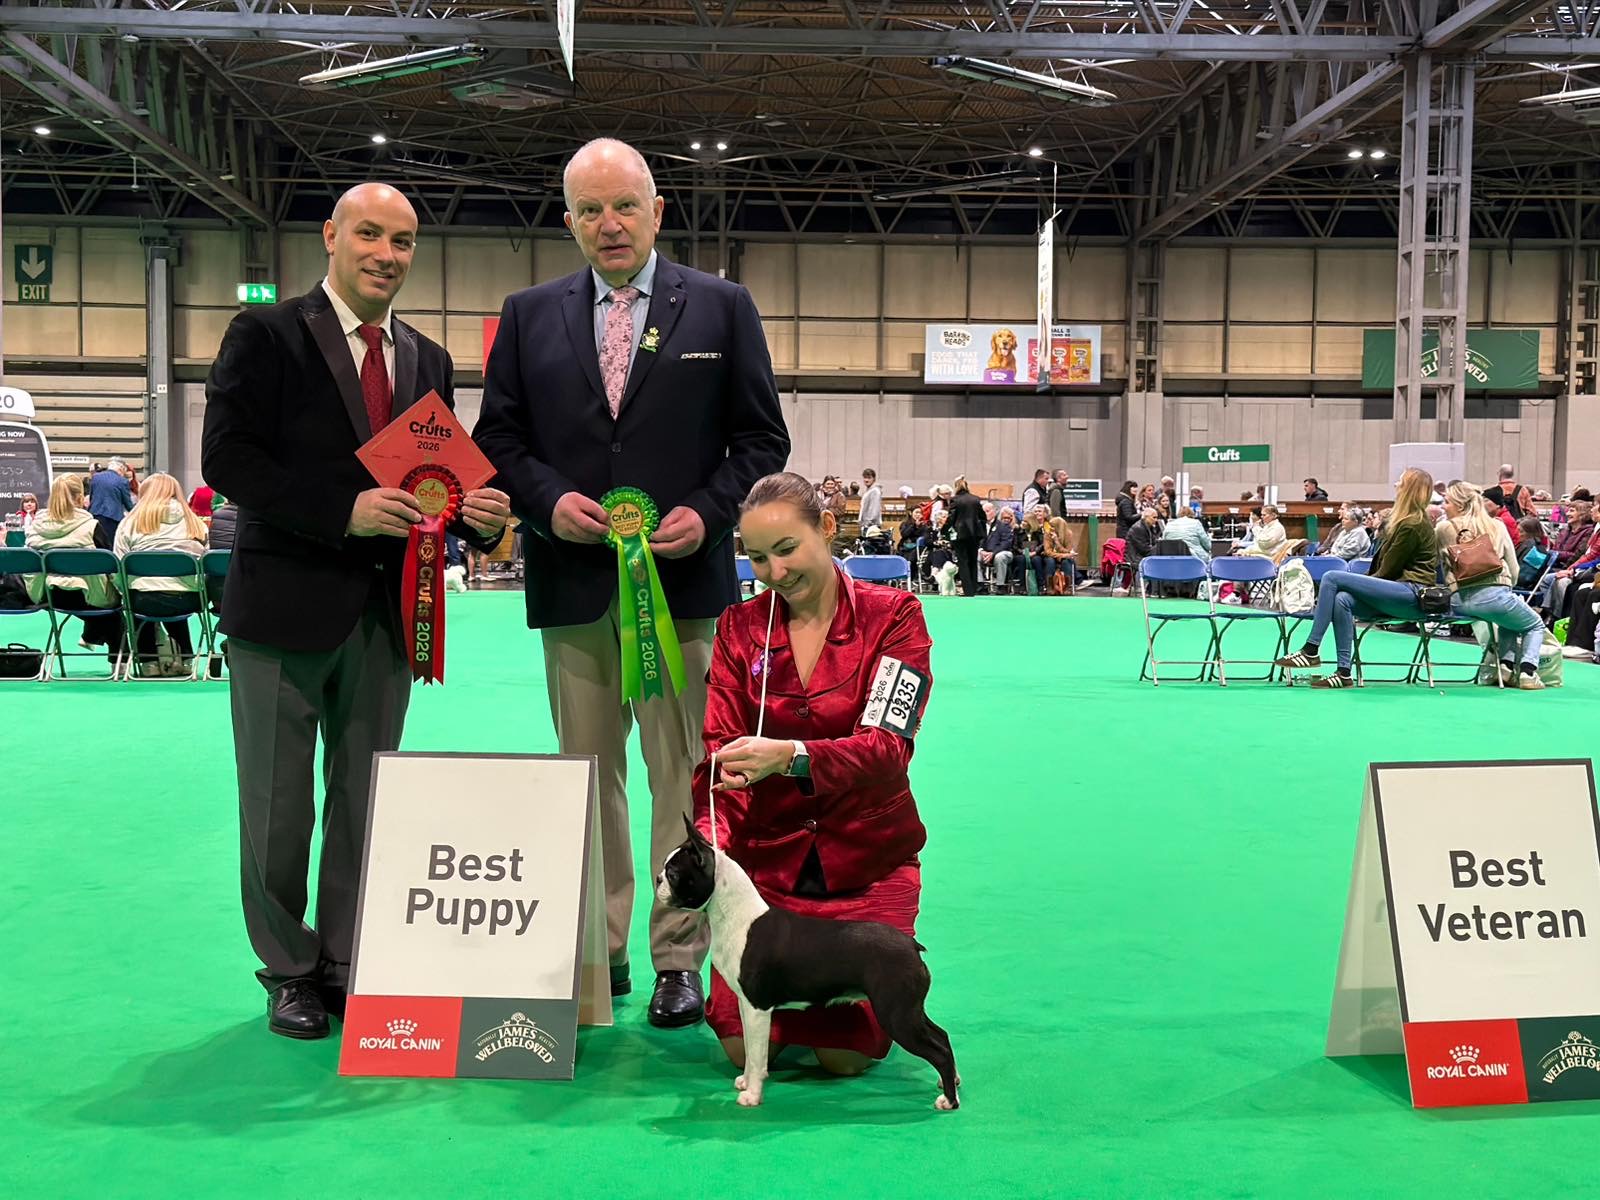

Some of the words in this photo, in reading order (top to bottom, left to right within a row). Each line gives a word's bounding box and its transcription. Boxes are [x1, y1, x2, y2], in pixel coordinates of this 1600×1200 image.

[22, 284, 48, 300] EXIT
[0, 395, 14, 408] 0
[409, 421, 452, 438] Crufts
[417, 440, 440, 452] 2026
[1208, 447, 1240, 461] Crufts
[612, 511, 640, 522] Crufts
[417, 566, 434, 617] Crufts
[637, 588, 652, 637] Crufts
[416, 622, 431, 662] 2026
[641, 641, 657, 680] 2026
[874, 680, 888, 702] 2026
[428, 844, 524, 882] Best
[1449, 850, 1546, 889] Best
[406, 888, 540, 936] Puppy
[1417, 903, 1587, 943] Veteran
[498, 1026, 538, 1040] JAMES
[359, 1037, 398, 1050] ROYAL
[401, 1038, 441, 1051] CANIN
[474, 1037, 554, 1063] WELLBELOVED
[1559, 1045, 1597, 1060] JAMES
[1427, 1064, 1466, 1079] ROYAL
[1472, 1063, 1508, 1077] CANIN
